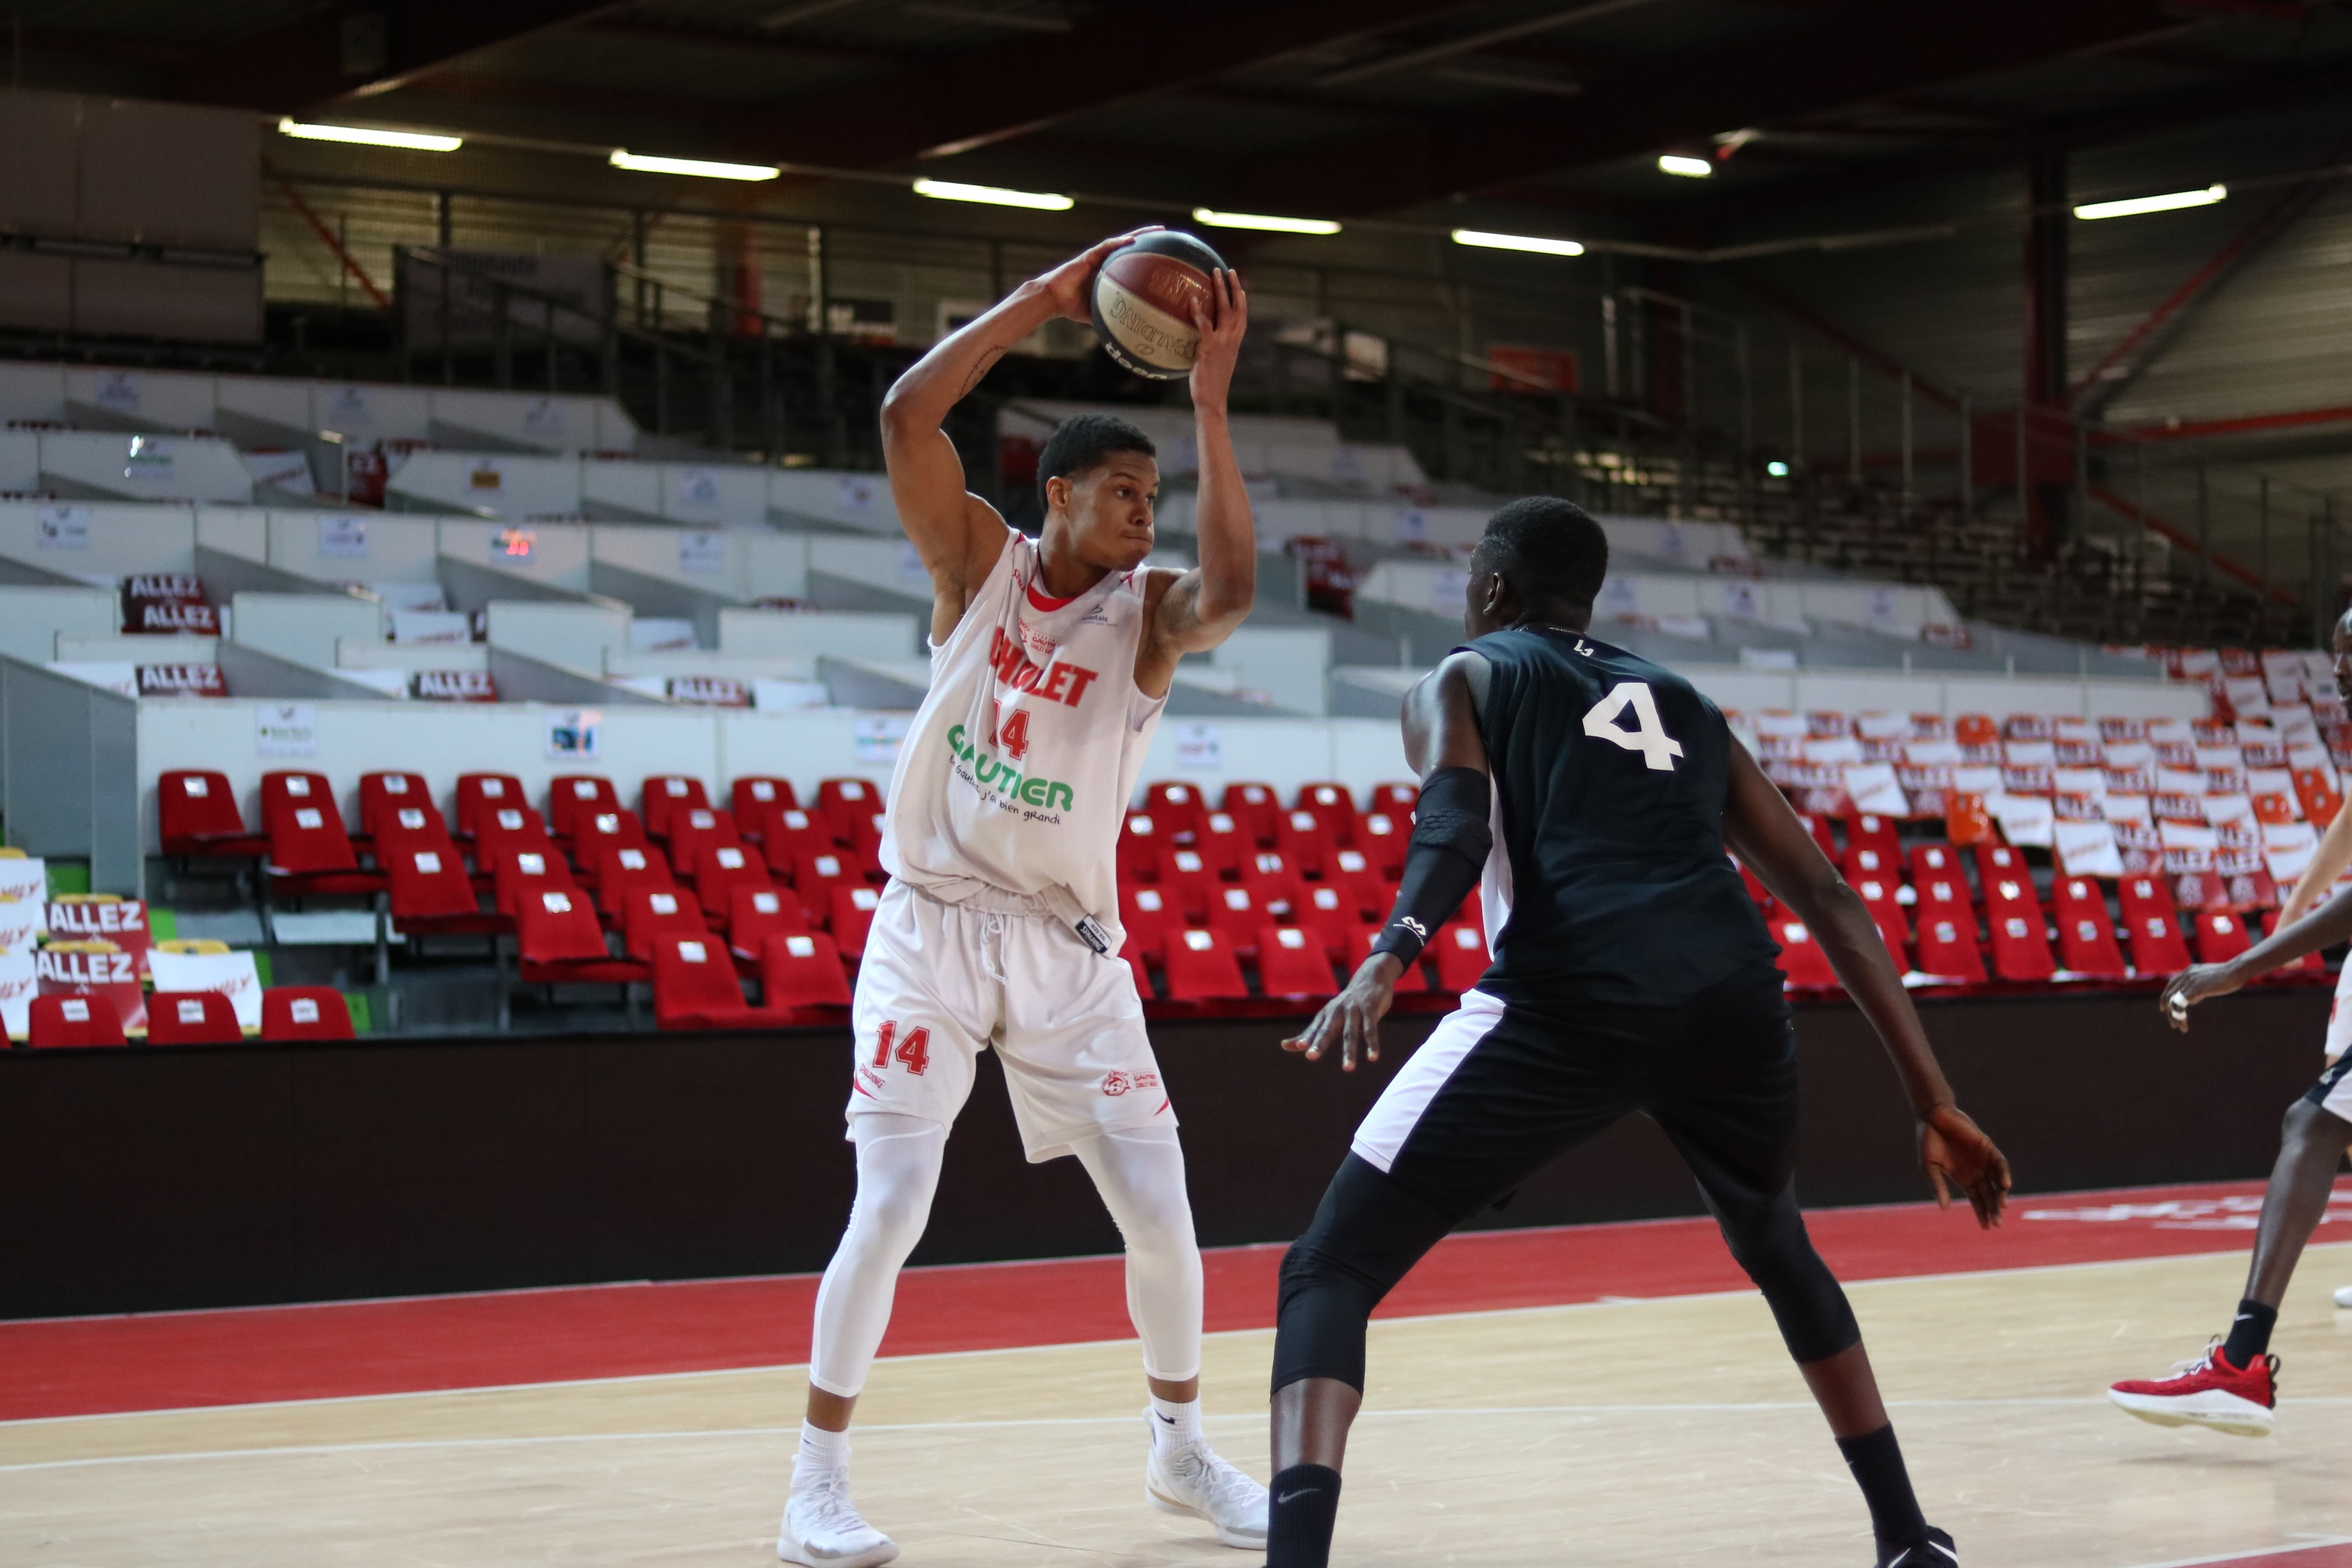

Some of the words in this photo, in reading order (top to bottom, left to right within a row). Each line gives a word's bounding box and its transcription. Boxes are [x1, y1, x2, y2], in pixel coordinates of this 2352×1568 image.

[1105, 341, 1167, 379] Jeep
[130, 575, 200, 598] ALLEZ
[144, 605, 213, 629] ALLEZ
[142, 665, 220, 689] ALLEZ
[420, 673, 492, 695] ALLEZ
[989, 699, 1030, 761] 14
[1582, 682, 1684, 771] 4
[947, 724, 1073, 812] GAUTIER
[981, 789, 997, 805] j'ai
[999, 800, 1019, 814] bien
[50, 904, 144, 933] ALLEZ
[36, 953, 134, 983] ALLEZ
[873, 1020, 930, 1076] 14
